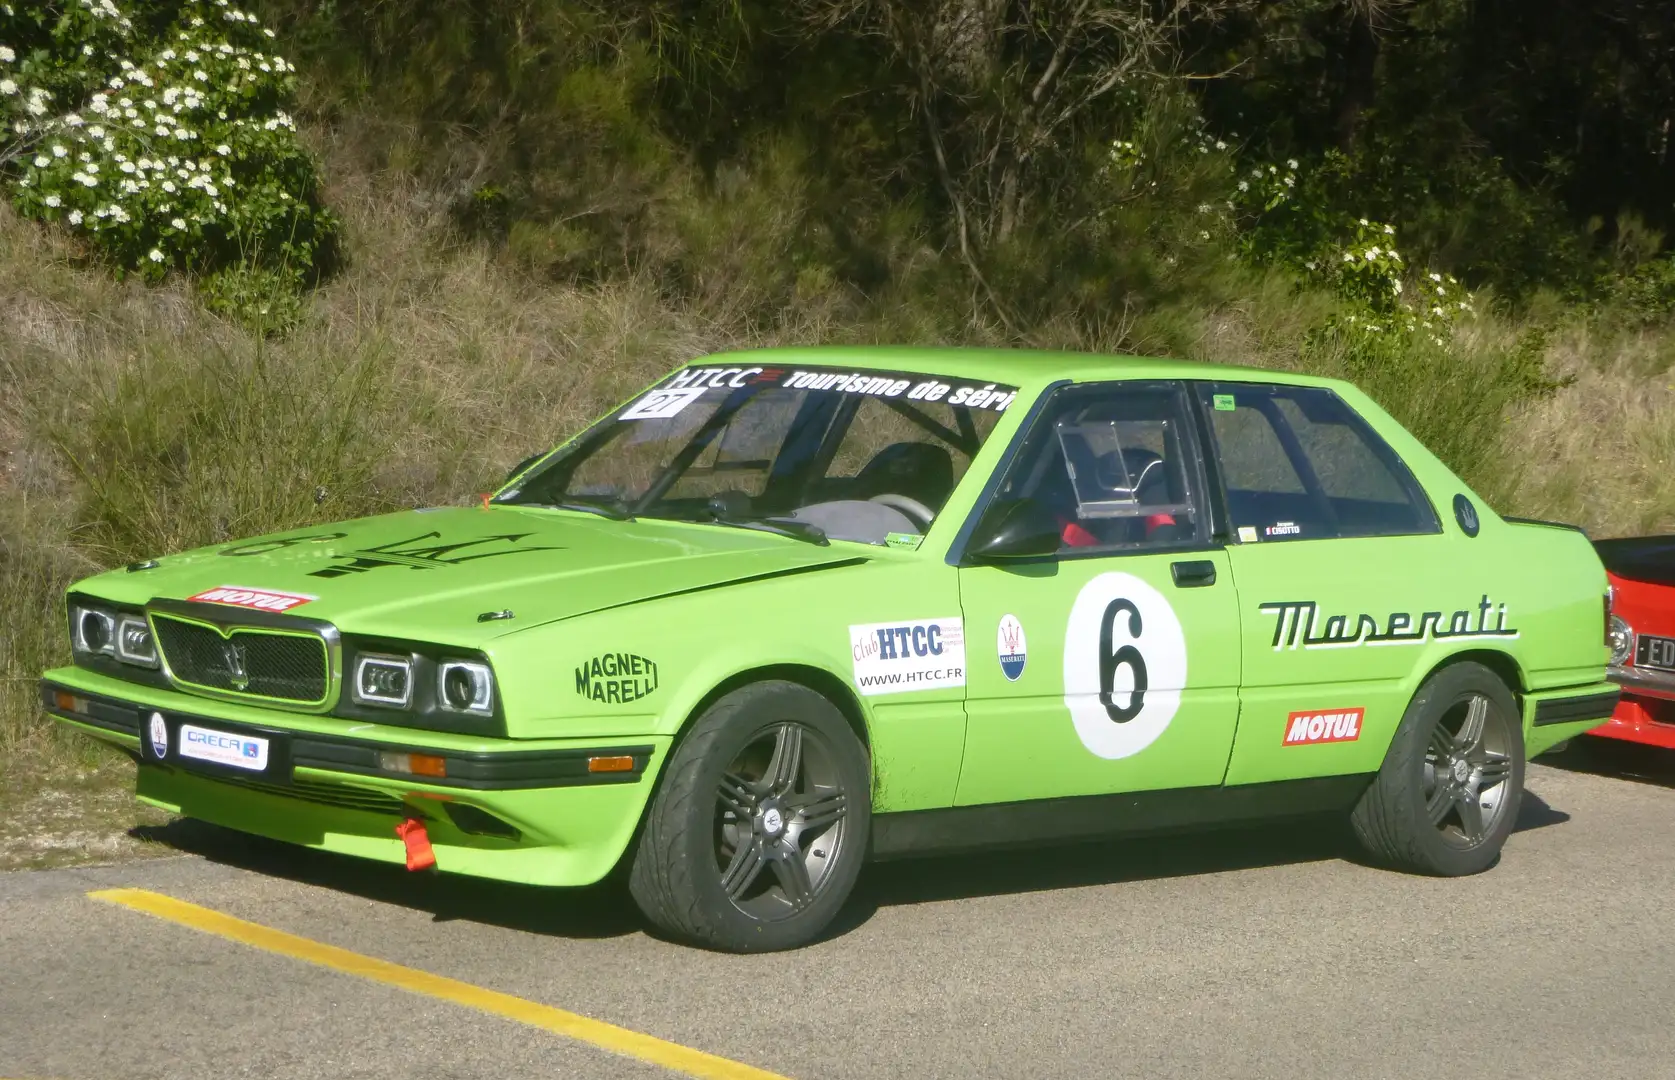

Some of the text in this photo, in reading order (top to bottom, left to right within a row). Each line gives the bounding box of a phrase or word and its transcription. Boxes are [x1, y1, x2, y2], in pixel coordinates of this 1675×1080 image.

[664, 367, 763, 390] HTCC
[783, 372, 1018, 411] Tourisme de séri
[637, 393, 689, 414] 27
[195, 589, 300, 610] MOTUL
[1258, 594, 1520, 650] Maserati
[853, 624, 944, 662] Club HTCC
[1648, 639, 1675, 666] ED
[575, 653, 658, 690] MAGNETI
[1099, 597, 1148, 724] 6
[575, 667, 658, 704] MARELLI
[860, 667, 963, 687] WWW.HTCC.FR
[187, 731, 241, 751] ORECA
[1286, 713, 1359, 742] MOTUL
